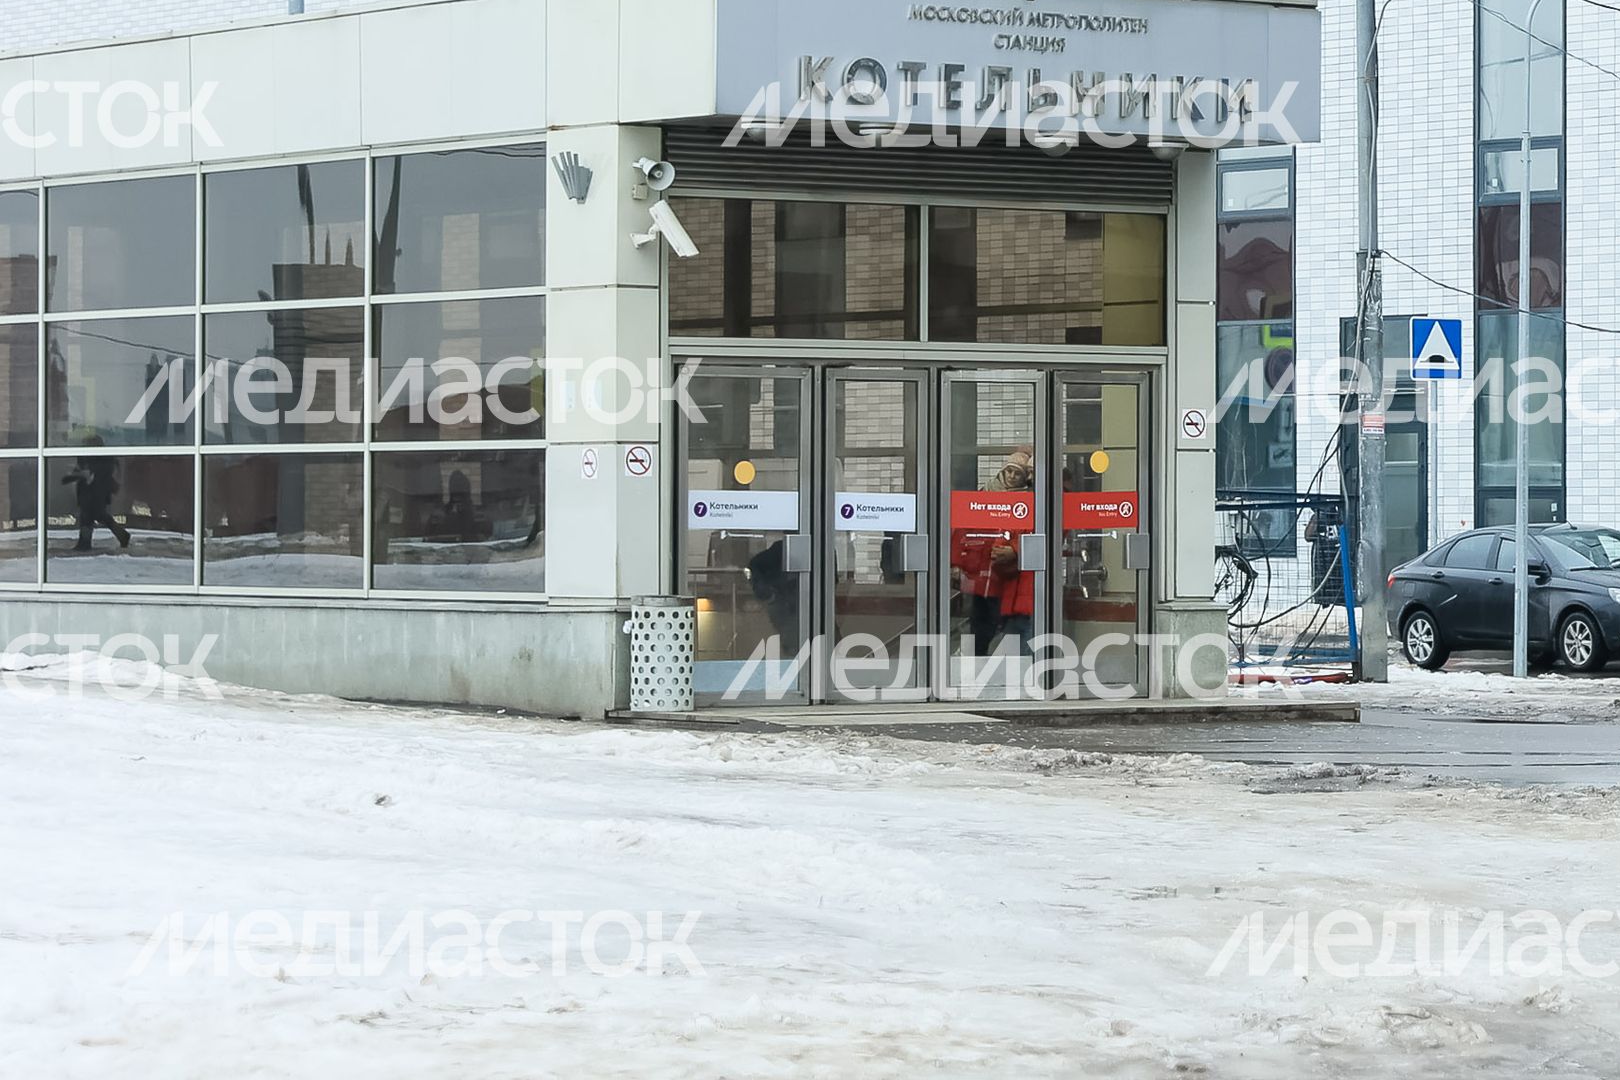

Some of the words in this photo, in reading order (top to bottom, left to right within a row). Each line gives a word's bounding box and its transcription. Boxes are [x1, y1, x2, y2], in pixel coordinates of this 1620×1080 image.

[907, 3, 1024, 26] МОСКОВСКИЙ
[1026, 11, 1148, 34] МЕТРОПОЛИТЕН
[993, 33, 1066, 54] СТАНЦИЯ
[797, 54, 1254, 123] КОТЕЛЬНИКИ
[698, 504, 704, 514] 7
[709, 501, 758, 511] Котельники
[844, 506, 851, 516] 7
[856, 503, 905, 513] Котельники
[970, 502, 986, 510] Нет
[987, 503, 1011, 511] входа
[1080, 503, 1095, 511] Нет
[1095, 503, 1118, 511] входа
